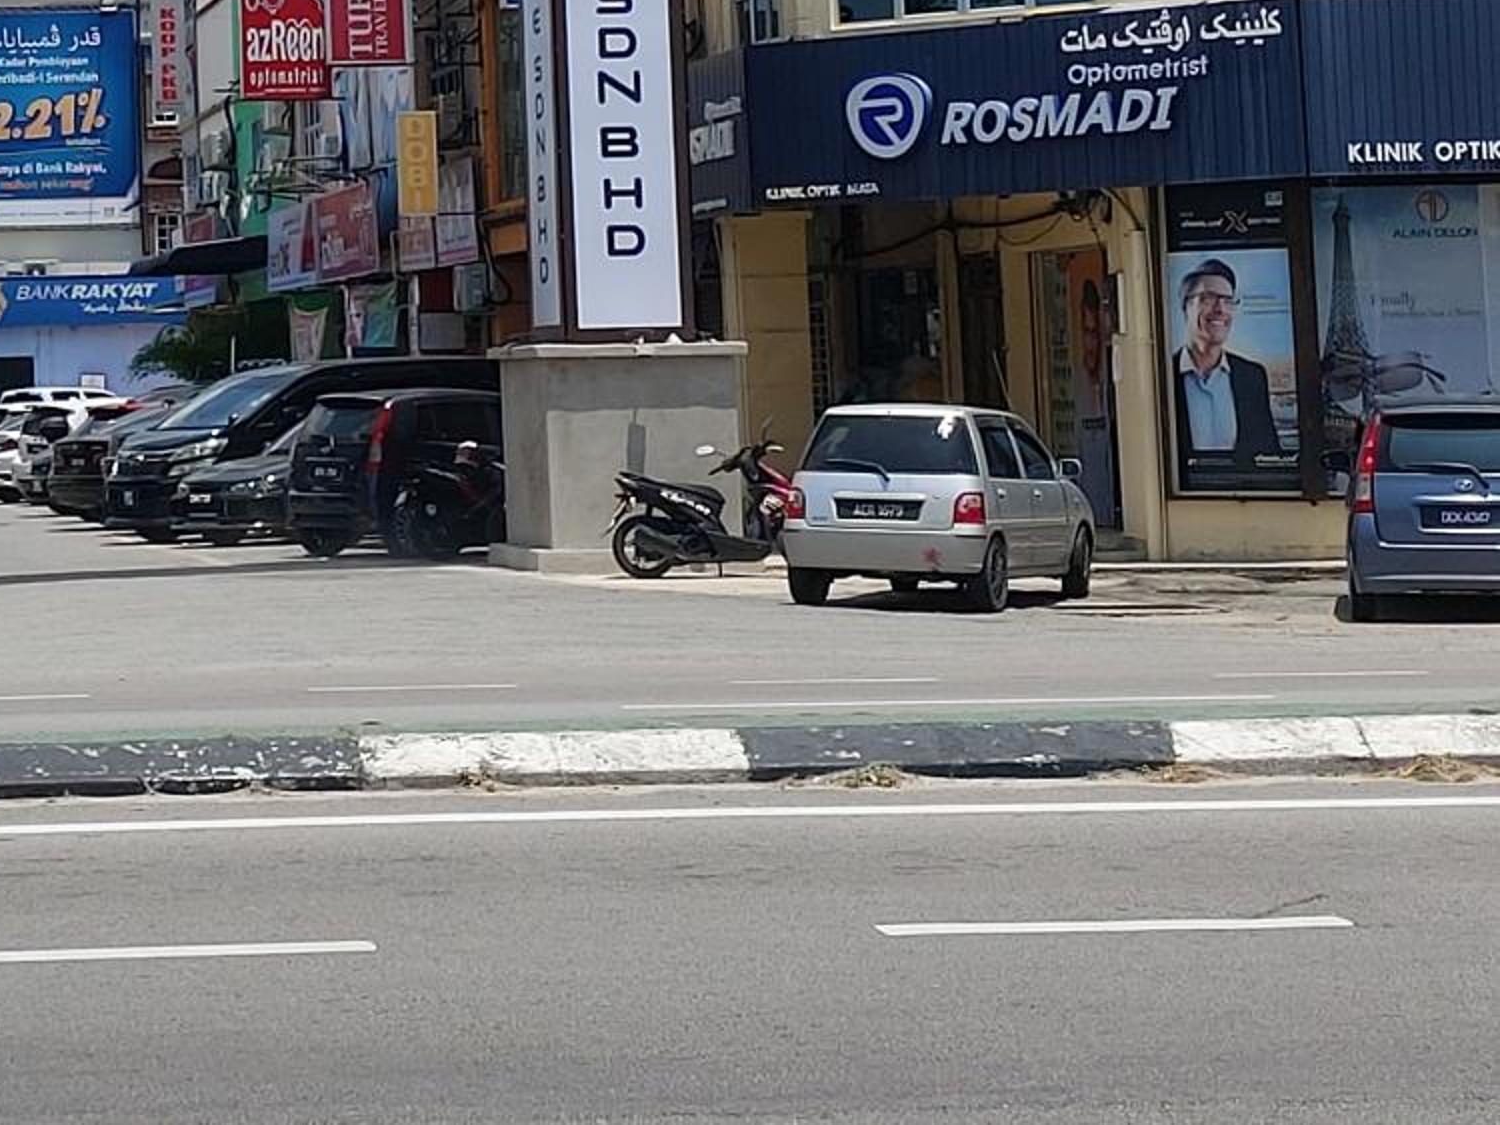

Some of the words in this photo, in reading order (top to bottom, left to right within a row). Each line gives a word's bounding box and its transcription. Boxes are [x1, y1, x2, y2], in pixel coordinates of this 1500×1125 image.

[1067, 54, 1208, 88] Optometrist
[941, 86, 1178, 145] ROSMADI
[1348, 141, 1423, 163] KLINIK
[22, 162, 33, 174] di
[36, 162, 64, 174] Bank
[807, 184, 841, 197] OPTIK
